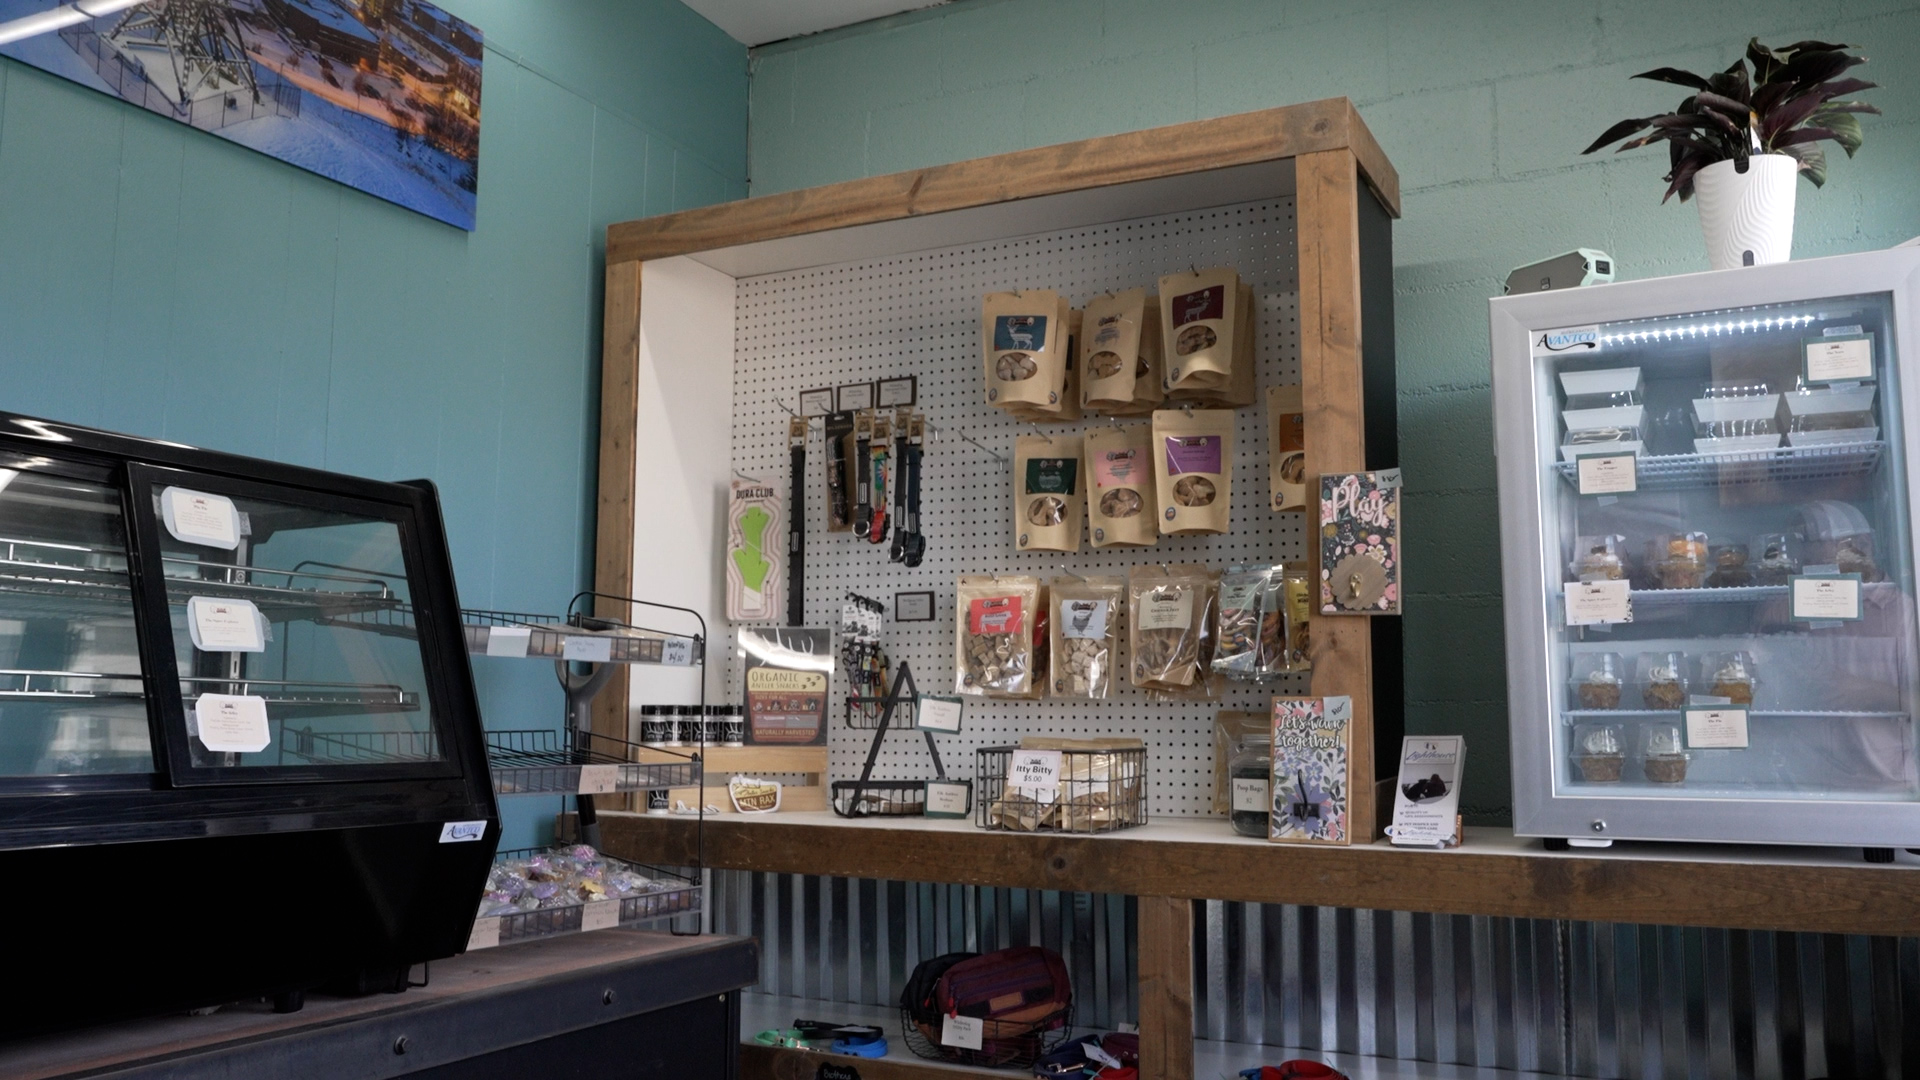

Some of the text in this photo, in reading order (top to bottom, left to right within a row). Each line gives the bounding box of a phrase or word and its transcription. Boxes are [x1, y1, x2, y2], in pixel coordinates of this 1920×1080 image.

[1536, 332, 1596, 351] AVANTCO
[736, 488, 774, 500] DURA CLUB
[1332, 486, 1386, 526] Play
[752, 671, 799, 682] ORGANIC
[1278, 716, 1306, 730] Let's
[1282, 732, 1340, 750] together!
[1406, 751, 1456, 760] Lighthouse
[1016, 765, 1052, 775] Itty Bitty
[1237, 784, 1248, 792] Poop
[739, 795, 775, 806] MTN RAX
